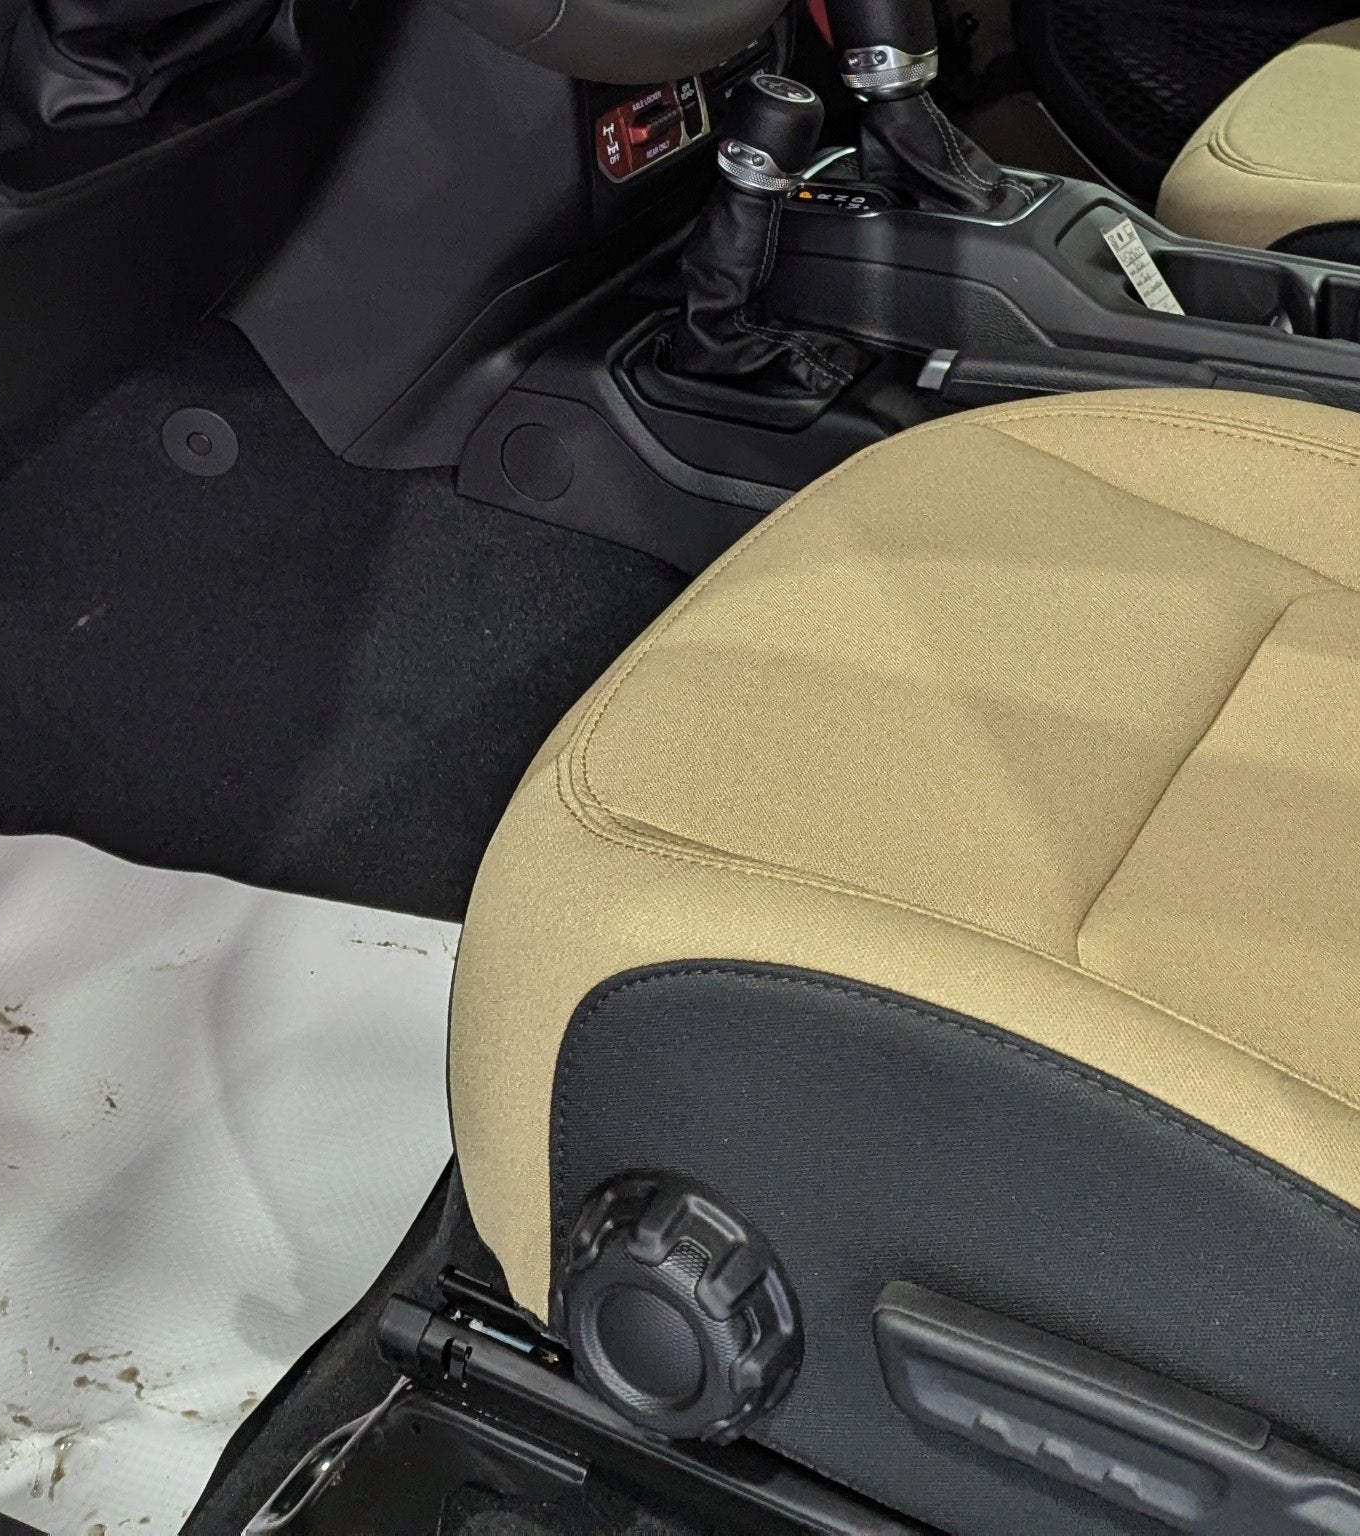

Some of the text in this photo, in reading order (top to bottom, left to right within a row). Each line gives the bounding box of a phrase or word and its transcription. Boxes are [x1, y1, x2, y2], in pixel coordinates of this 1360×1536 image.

[632, 90, 662, 112] AXLE LOCKER
[609, 153, 621, 165] OFF
[646, 140, 670, 159] REAR ONLY
